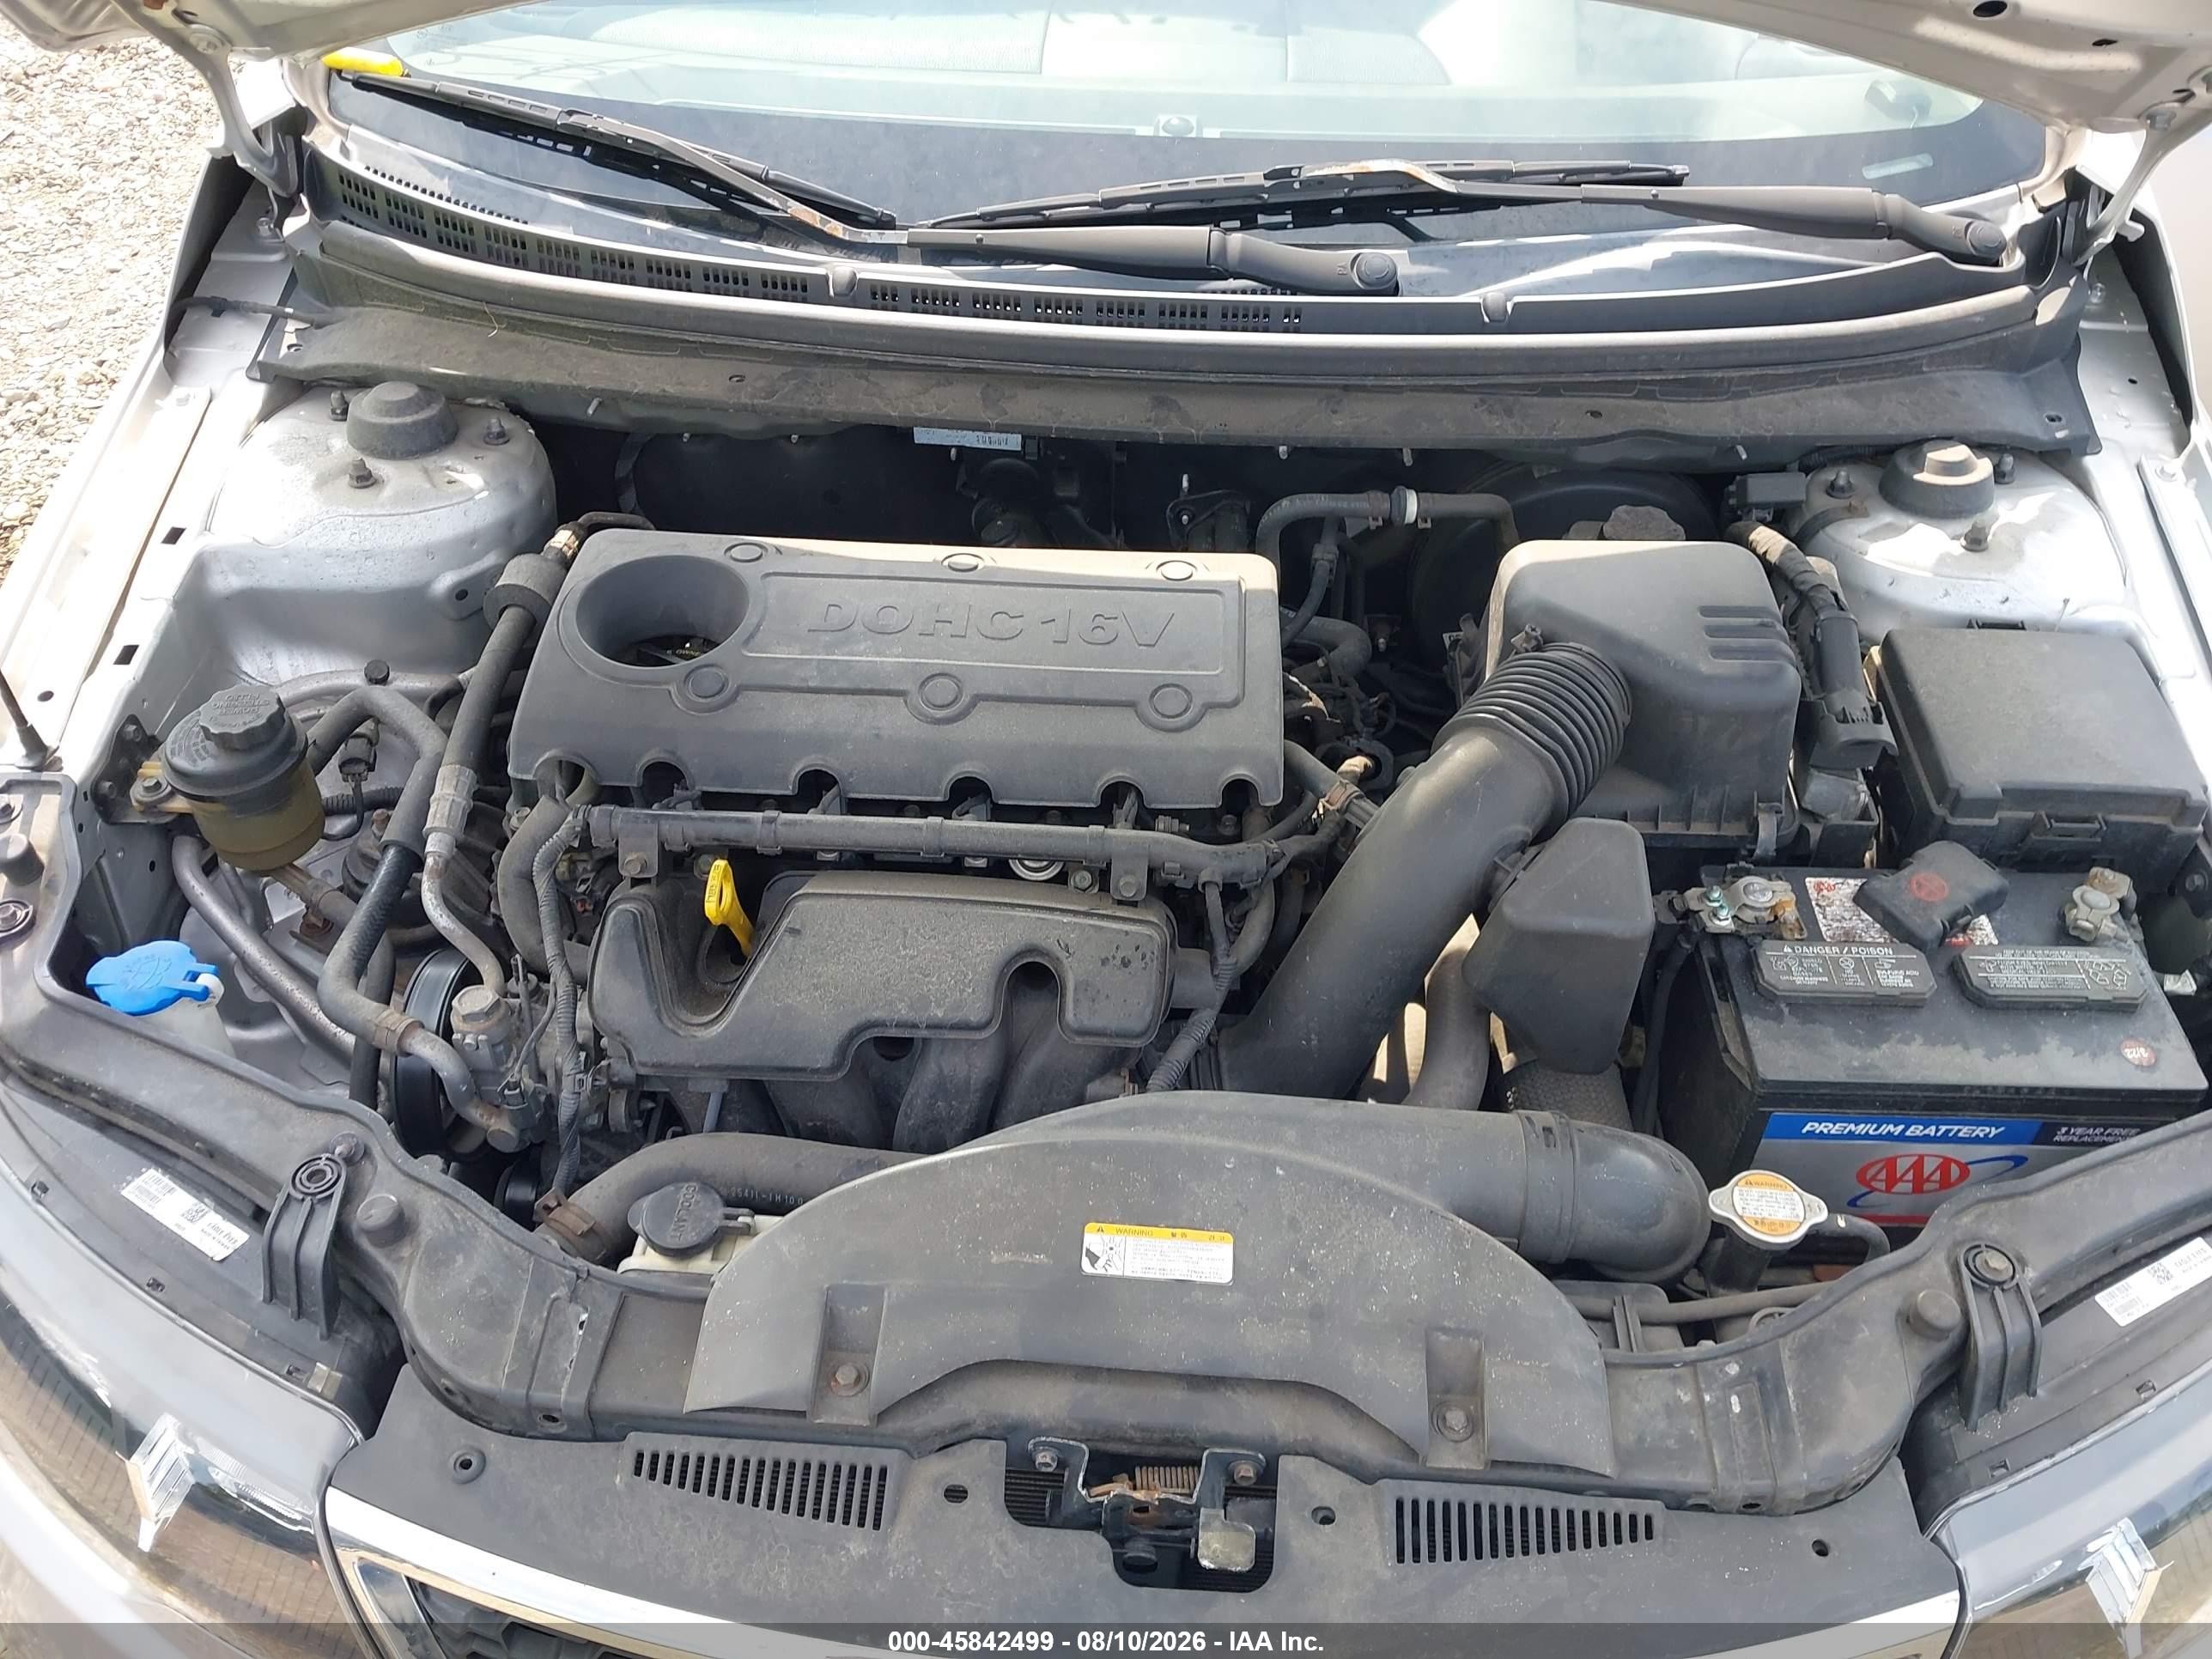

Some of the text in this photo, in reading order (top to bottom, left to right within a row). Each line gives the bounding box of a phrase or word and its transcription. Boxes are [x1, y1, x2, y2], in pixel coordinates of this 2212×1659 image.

[808, 603, 1175, 647] DOHC 16V
[1795, 945, 1840, 954] DANGER
[1851, 947, 1893, 956] POISON
[1802, 1121, 2006, 1138] PREMIUM BATTERY
[2068, 1127, 2104, 1136] YEAR
[2104, 1127, 2141, 1136] FREE
[1862, 1154, 1962, 1194] AAA
[667, 1182, 699, 1242] COOLANT
[1116, 1227, 1153, 1237] WARNING
